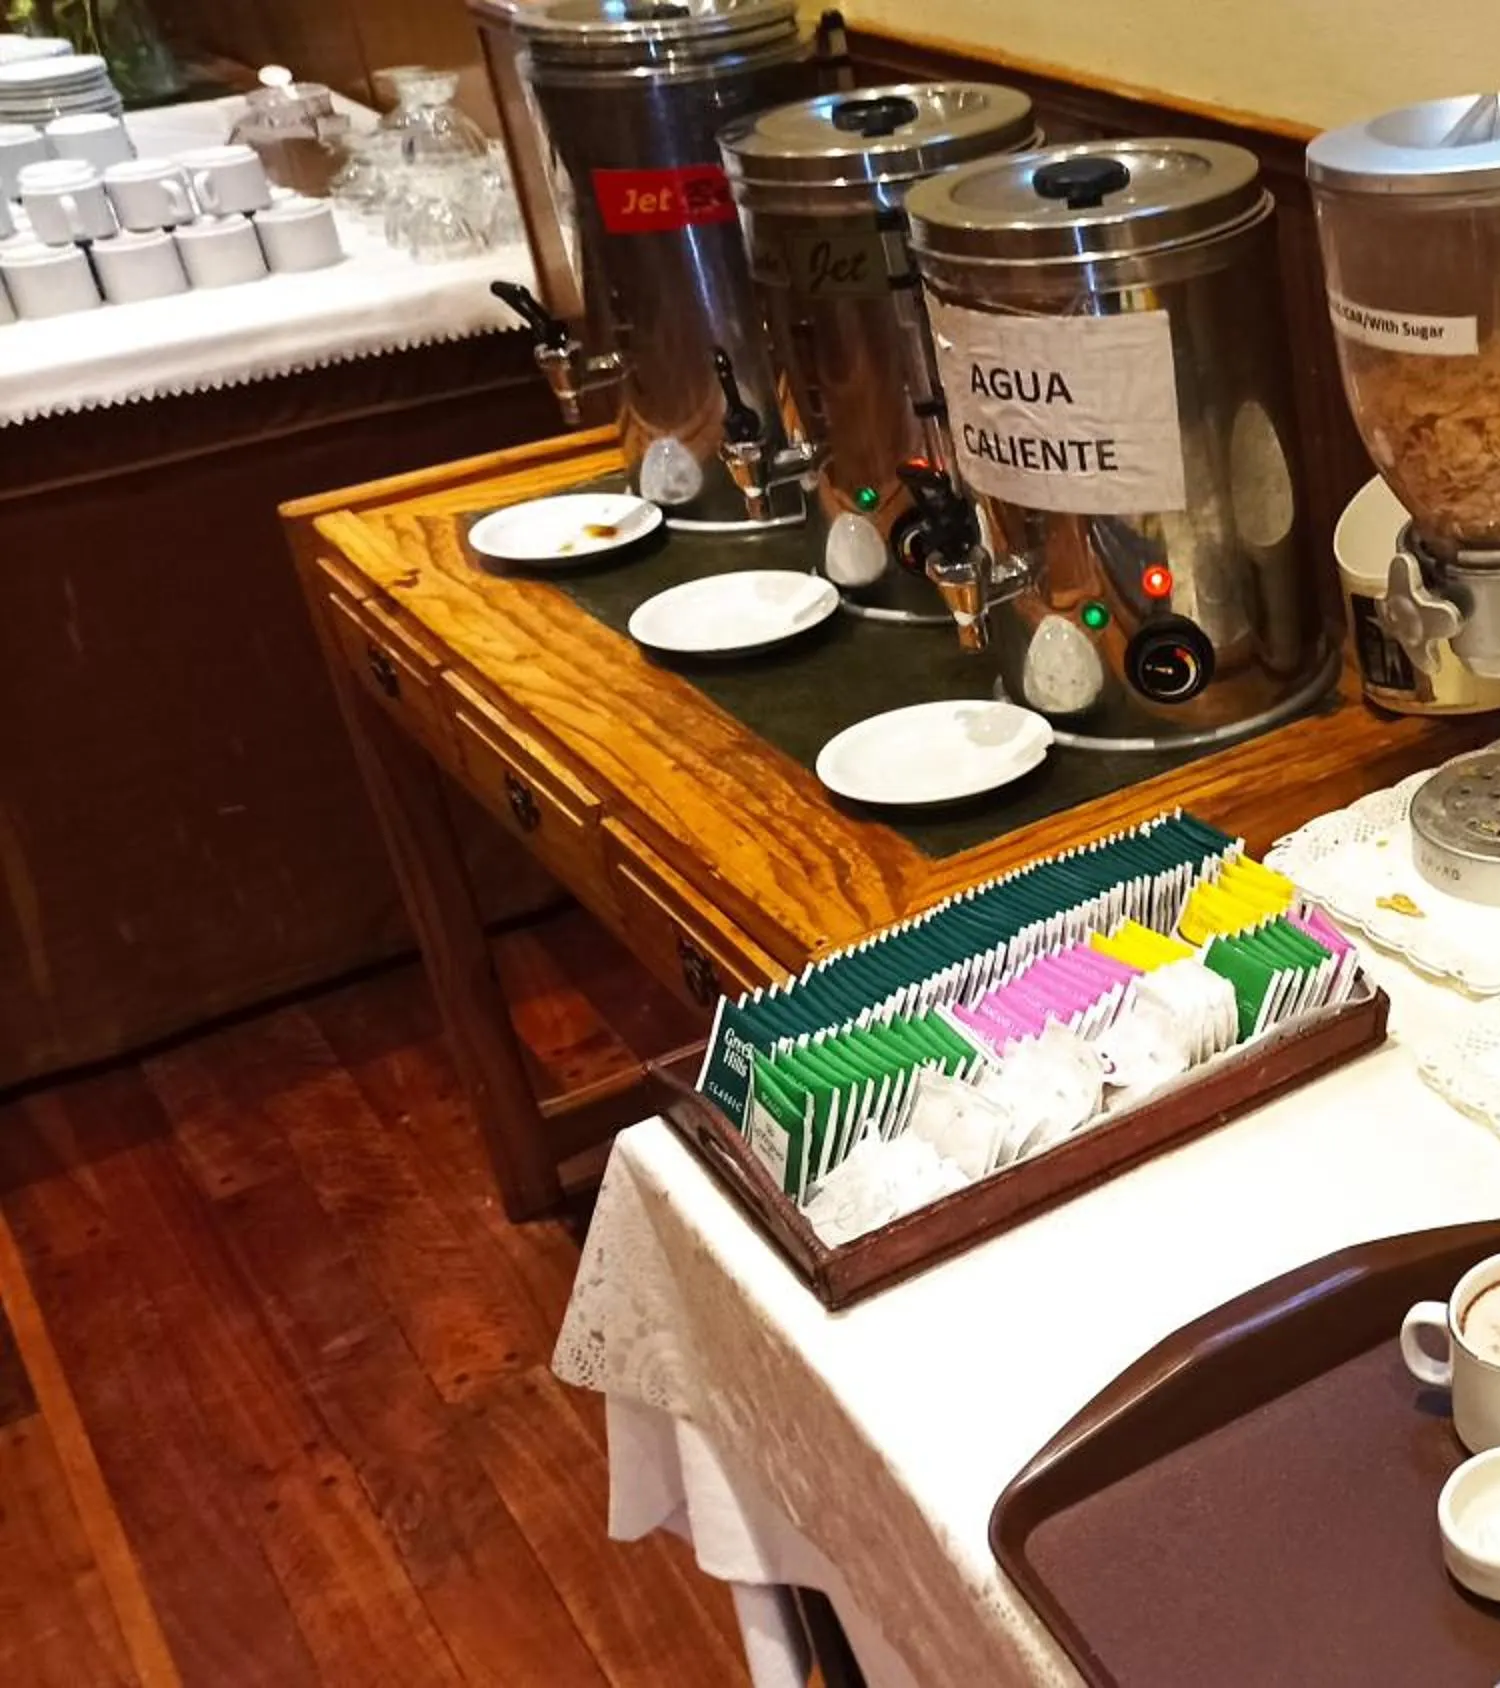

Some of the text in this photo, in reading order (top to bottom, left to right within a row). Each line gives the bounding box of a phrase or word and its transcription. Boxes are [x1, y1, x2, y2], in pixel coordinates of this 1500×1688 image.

[621, 187, 673, 214] Jet
[1402, 321, 1444, 341] Sugar
[971, 362, 1074, 404] AGUA
[963, 423, 1119, 471] CALIENTE
[722, 1047, 747, 1077] Hills
